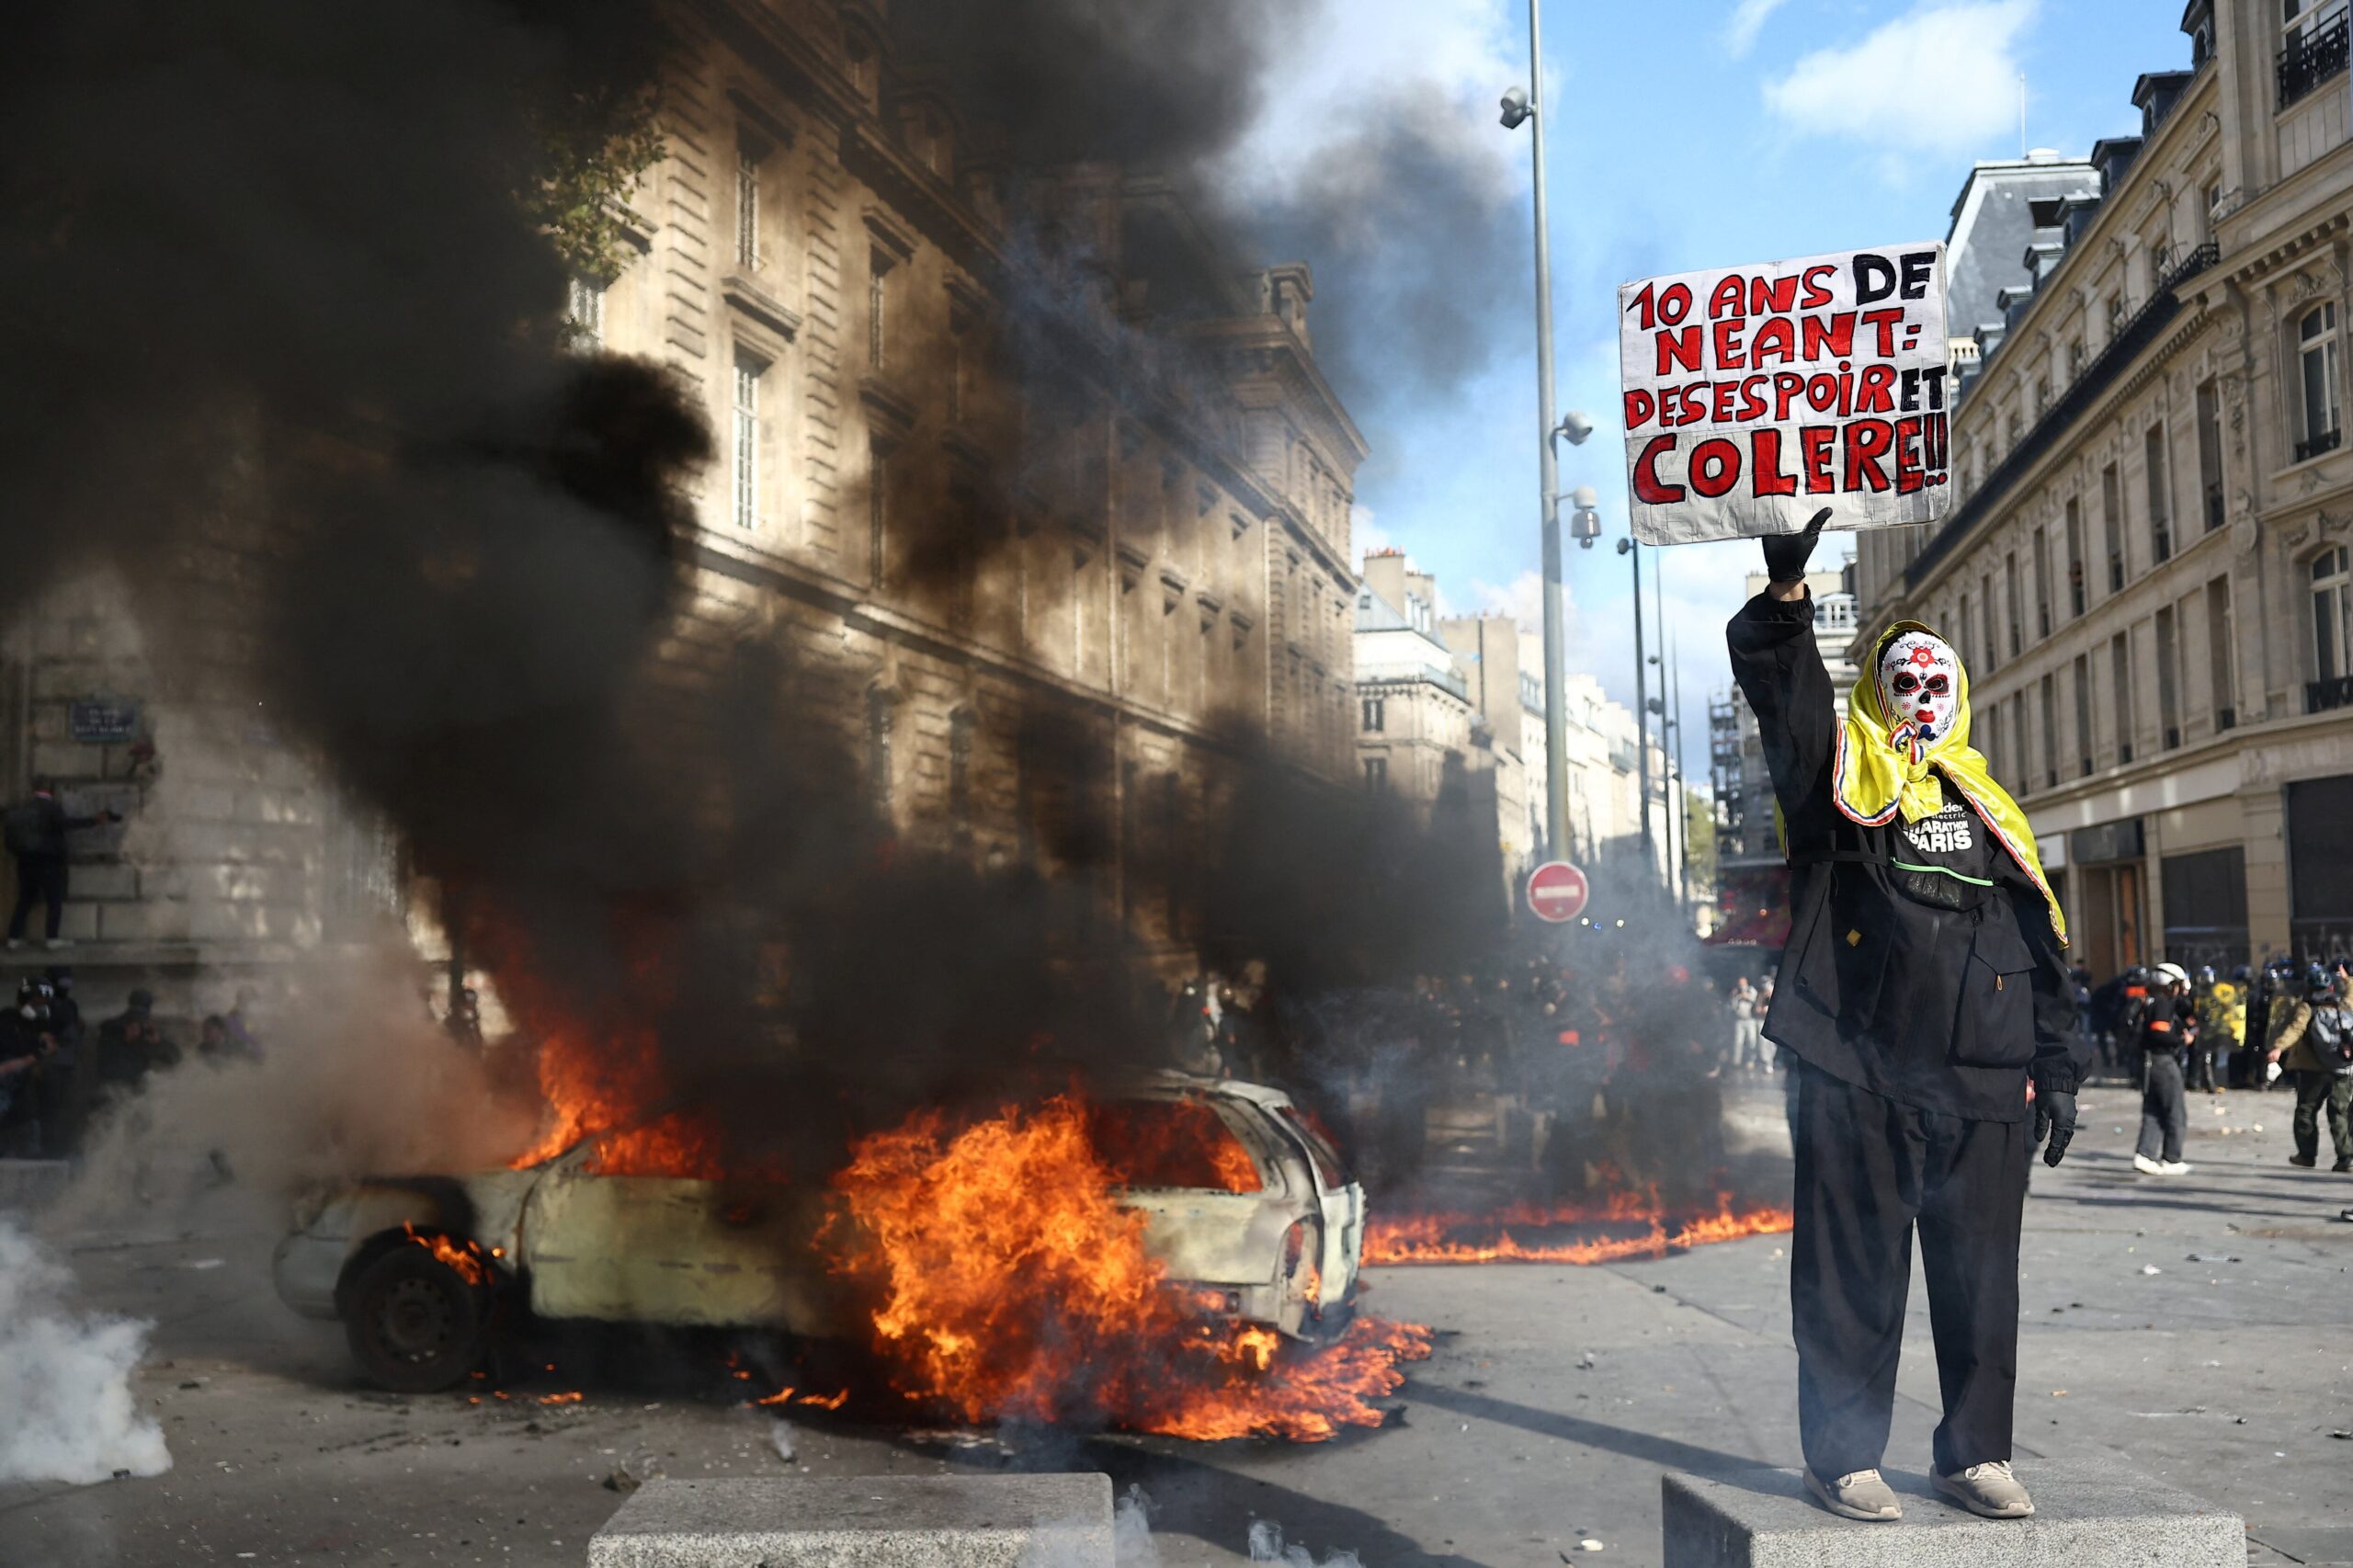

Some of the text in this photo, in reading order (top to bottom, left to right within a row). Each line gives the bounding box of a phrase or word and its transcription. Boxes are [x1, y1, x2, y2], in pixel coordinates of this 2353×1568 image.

[1627, 252, 1936, 331] 10 ANS DE
[1655, 307, 1921, 375] NEANT:
[1901, 366, 1947, 411] ET
